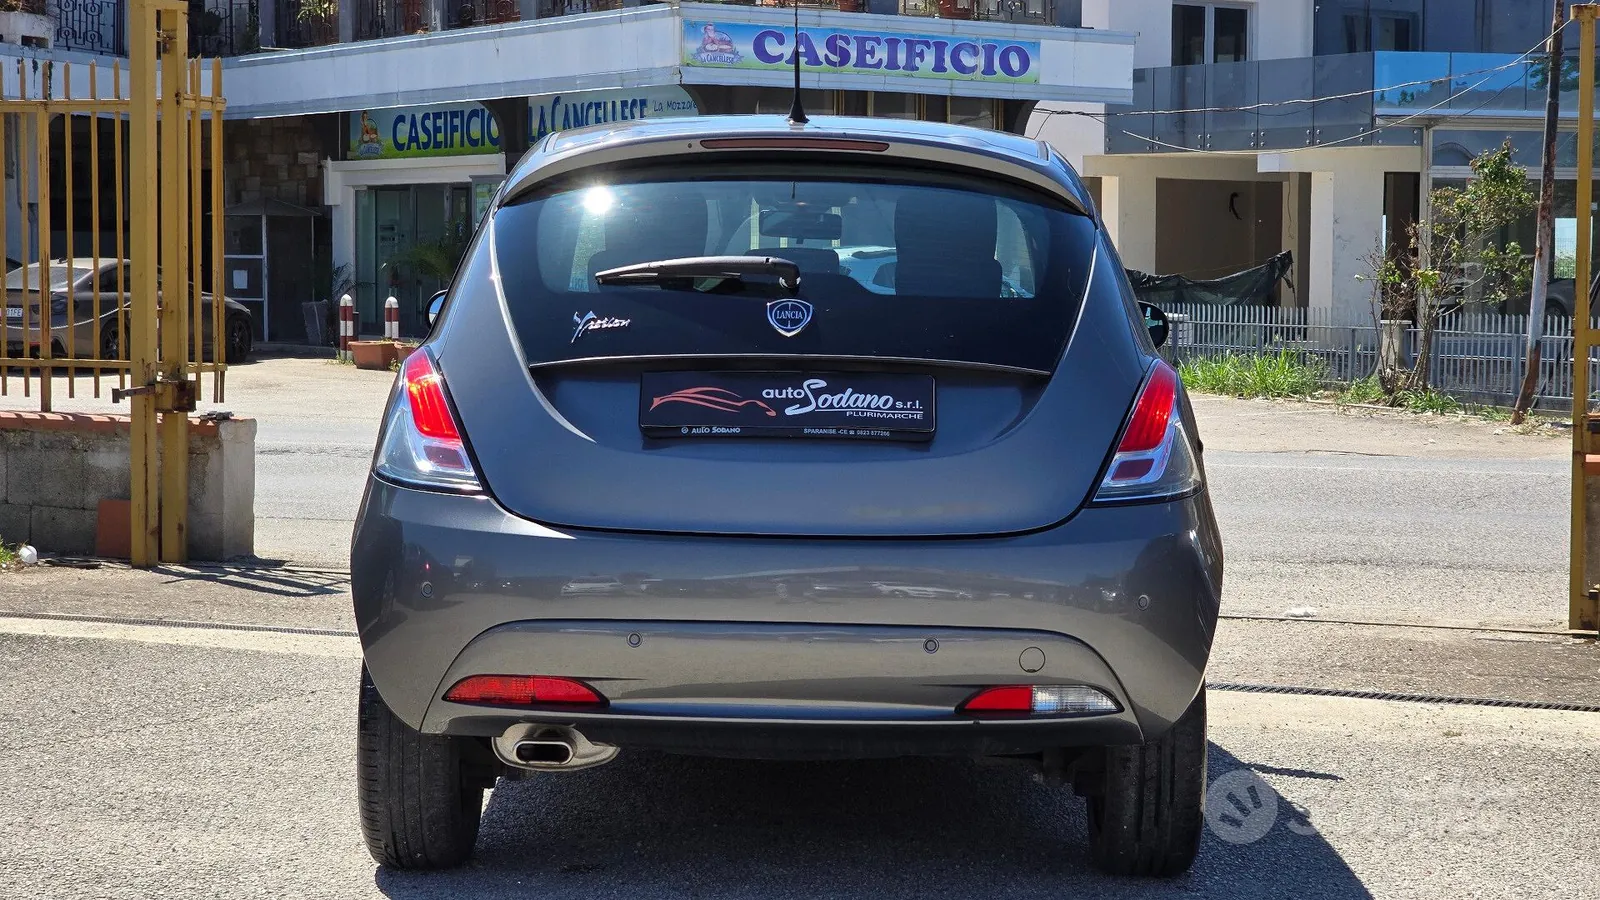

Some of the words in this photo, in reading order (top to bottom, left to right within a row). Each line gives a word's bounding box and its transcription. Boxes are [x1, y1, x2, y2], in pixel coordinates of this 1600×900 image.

[752, 29, 1031, 78] CASEIFICIO
[392, 109, 500, 151] CASEIFICIO
[776, 310, 803, 319] LANCIA
[762, 387, 804, 399] auto
[785, 379, 893, 416] Sodano
[895, 400, 923, 409] s.r.l.
[846, 411, 923, 420] PLURIMARCHE
[691, 426, 710, 434] AUTO
